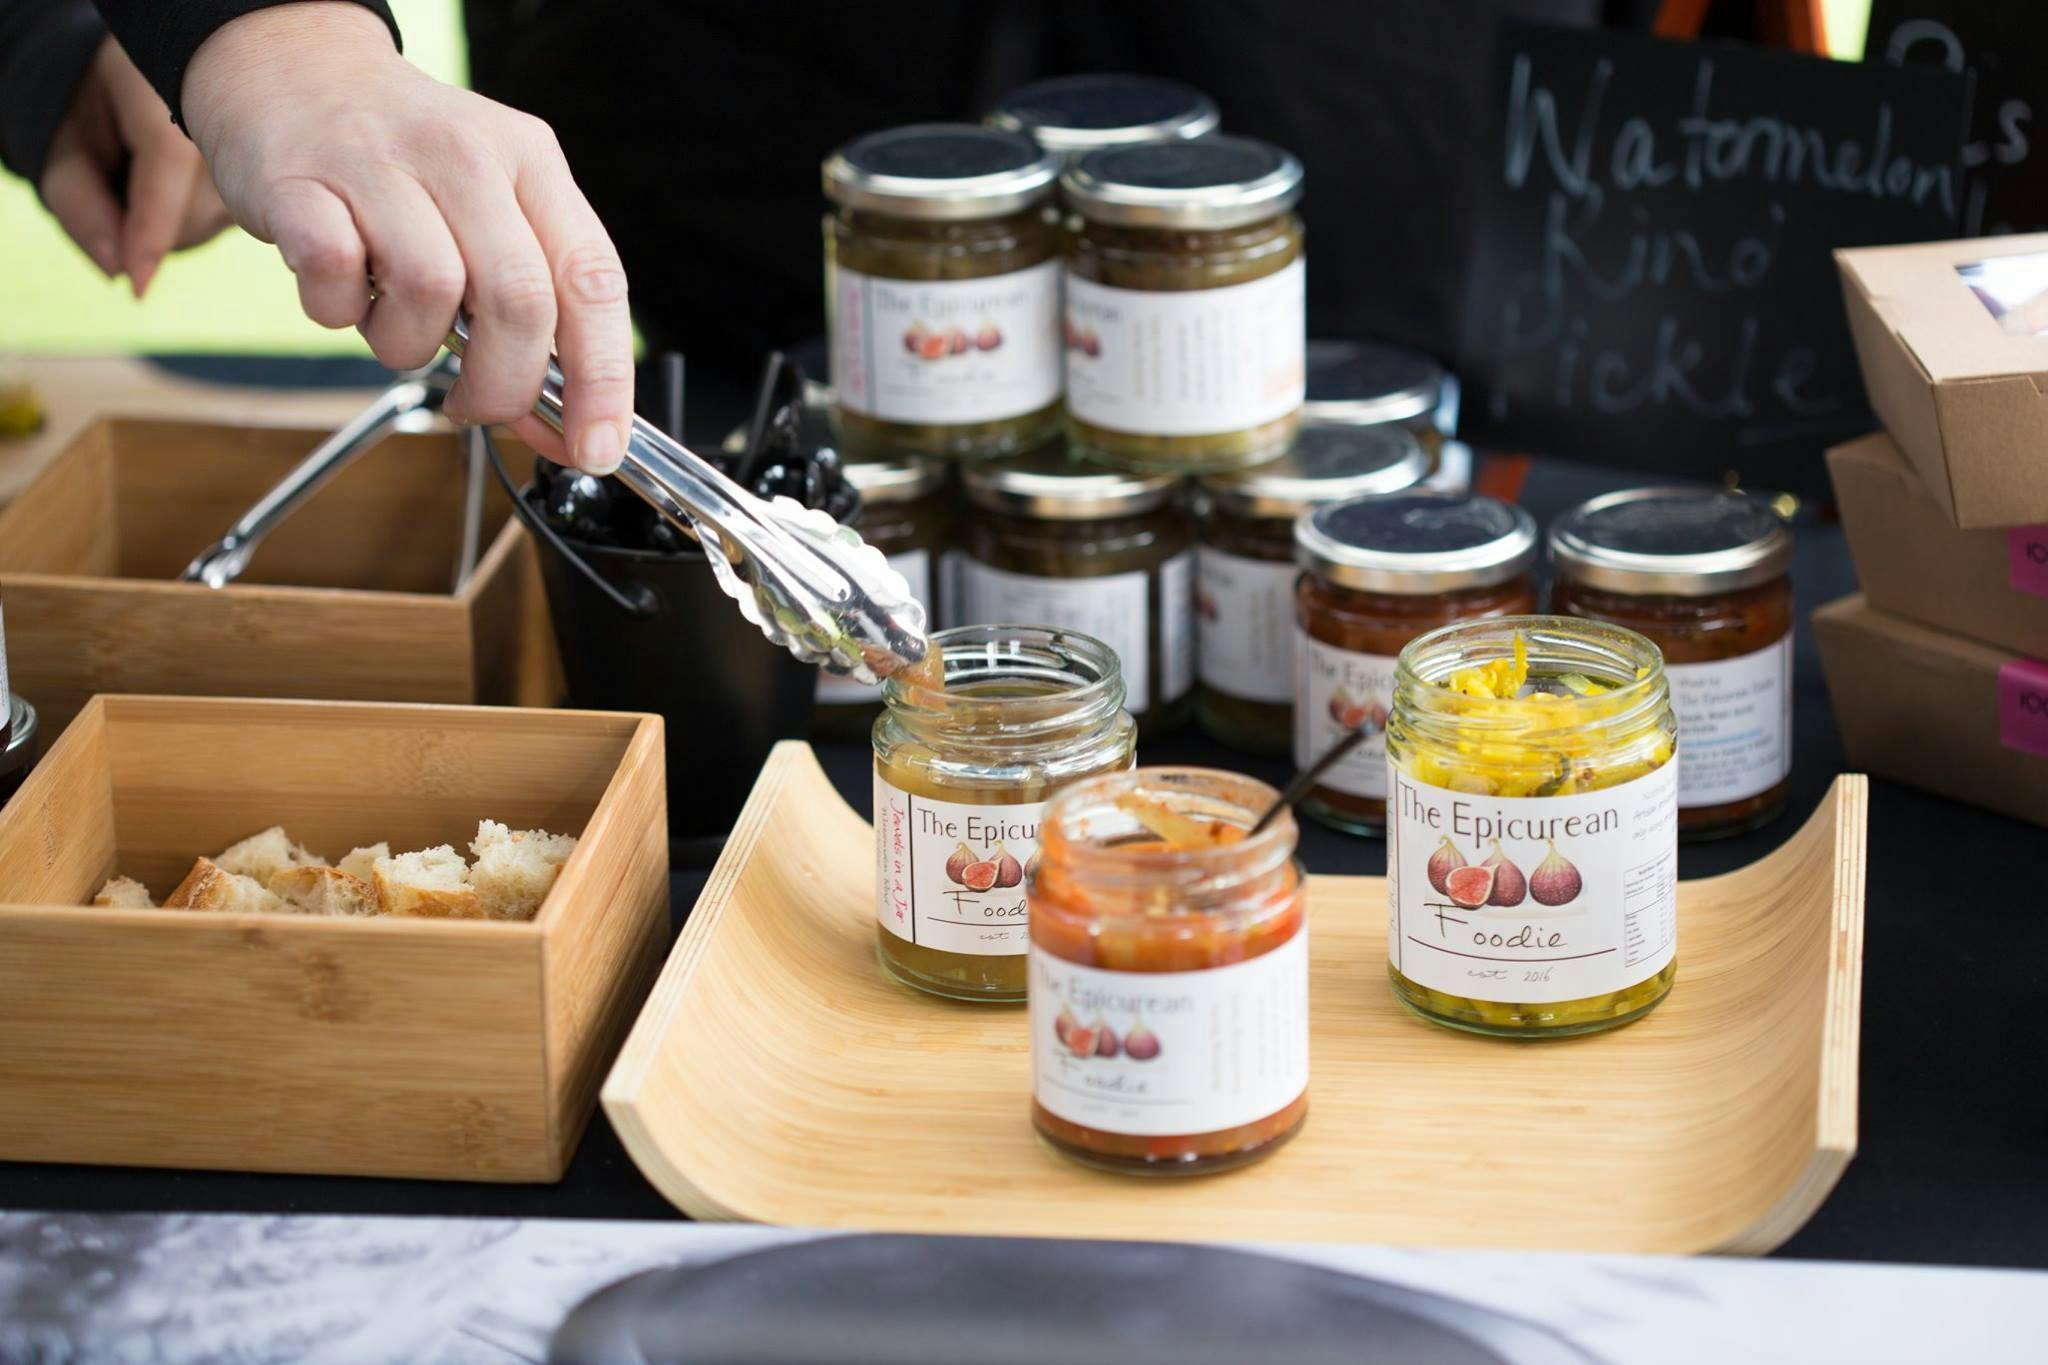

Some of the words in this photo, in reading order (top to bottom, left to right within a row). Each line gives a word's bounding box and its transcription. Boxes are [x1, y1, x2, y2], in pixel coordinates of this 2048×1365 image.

[1488, 286, 1842, 420] Pickle
[917, 808, 958, 838] The
[967, 816, 1038, 849] Epicu
[1400, 781, 1441, 829] The
[1453, 800, 1618, 849] Epicurean
[942, 890, 1028, 918] Food
[1423, 903, 1568, 948] Foodie
[1523, 967, 1554, 983] 2016
